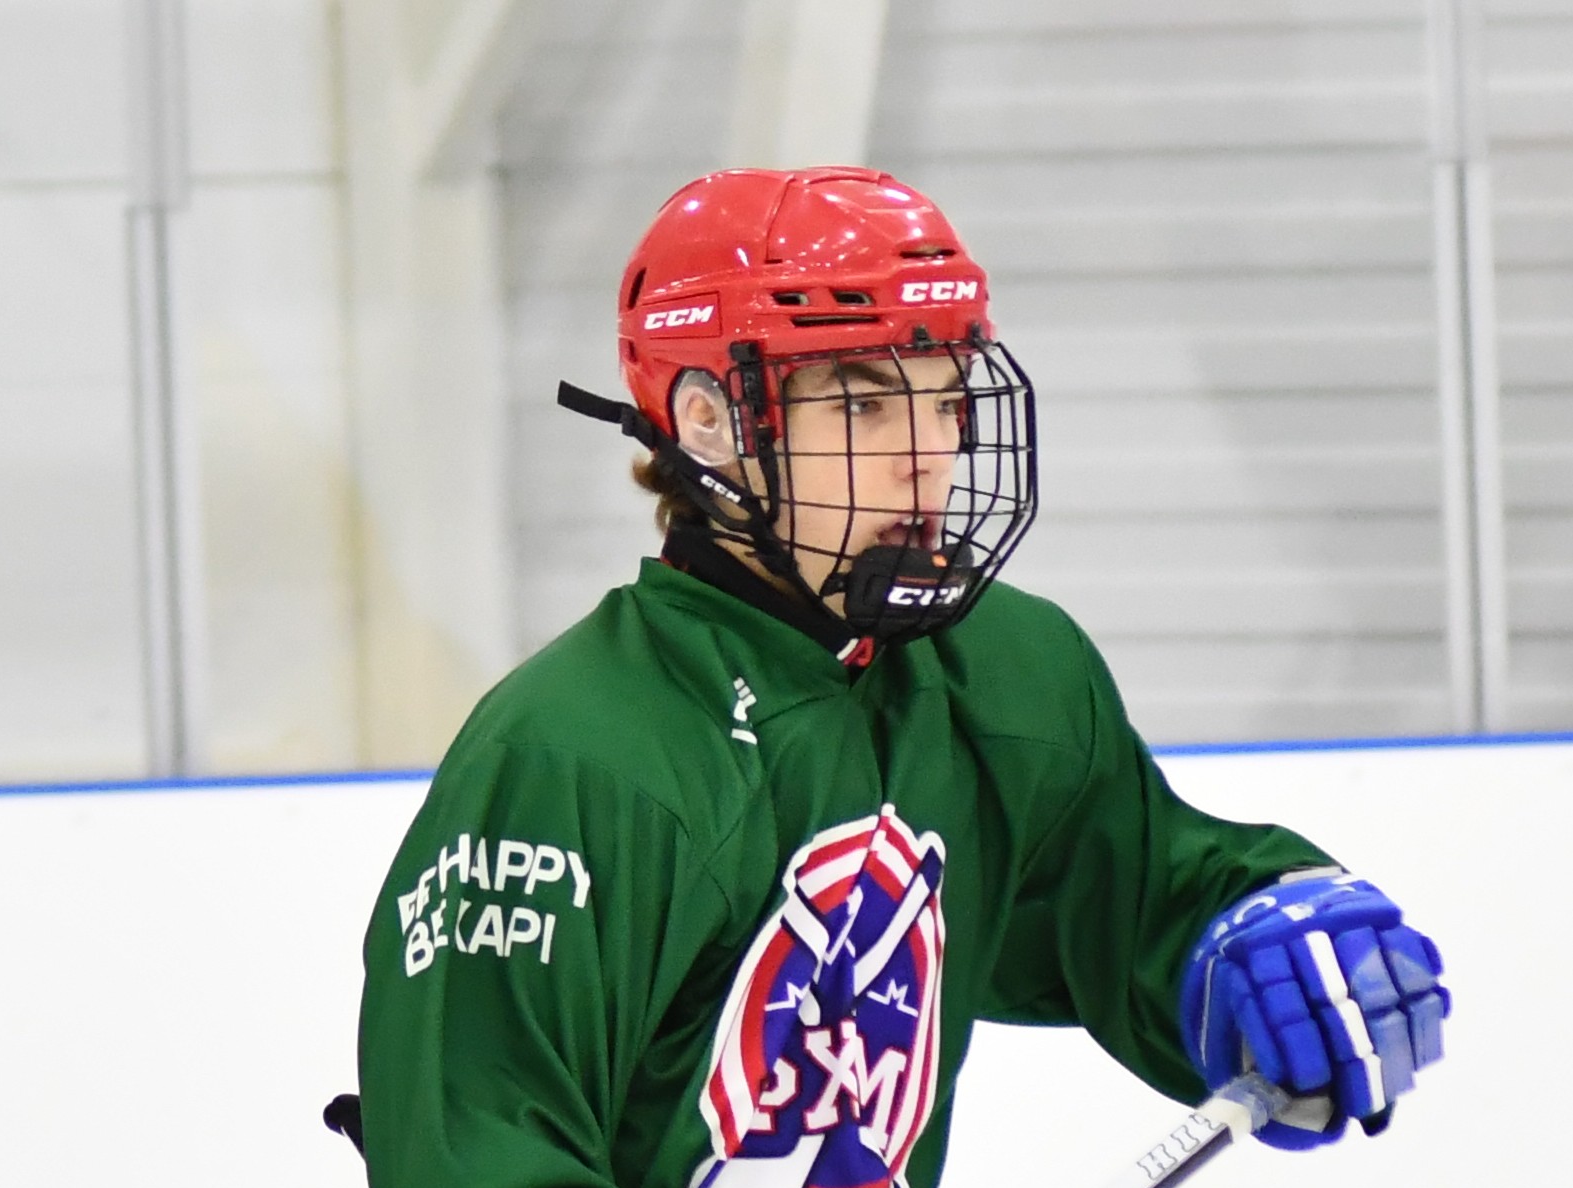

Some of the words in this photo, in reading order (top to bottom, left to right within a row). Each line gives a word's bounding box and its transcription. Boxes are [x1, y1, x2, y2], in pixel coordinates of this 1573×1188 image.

[902, 281, 978, 303] CCM
[644, 305, 714, 330] CCM
[700, 474, 742, 504] CCM
[438, 833, 591, 909] HAPPY
